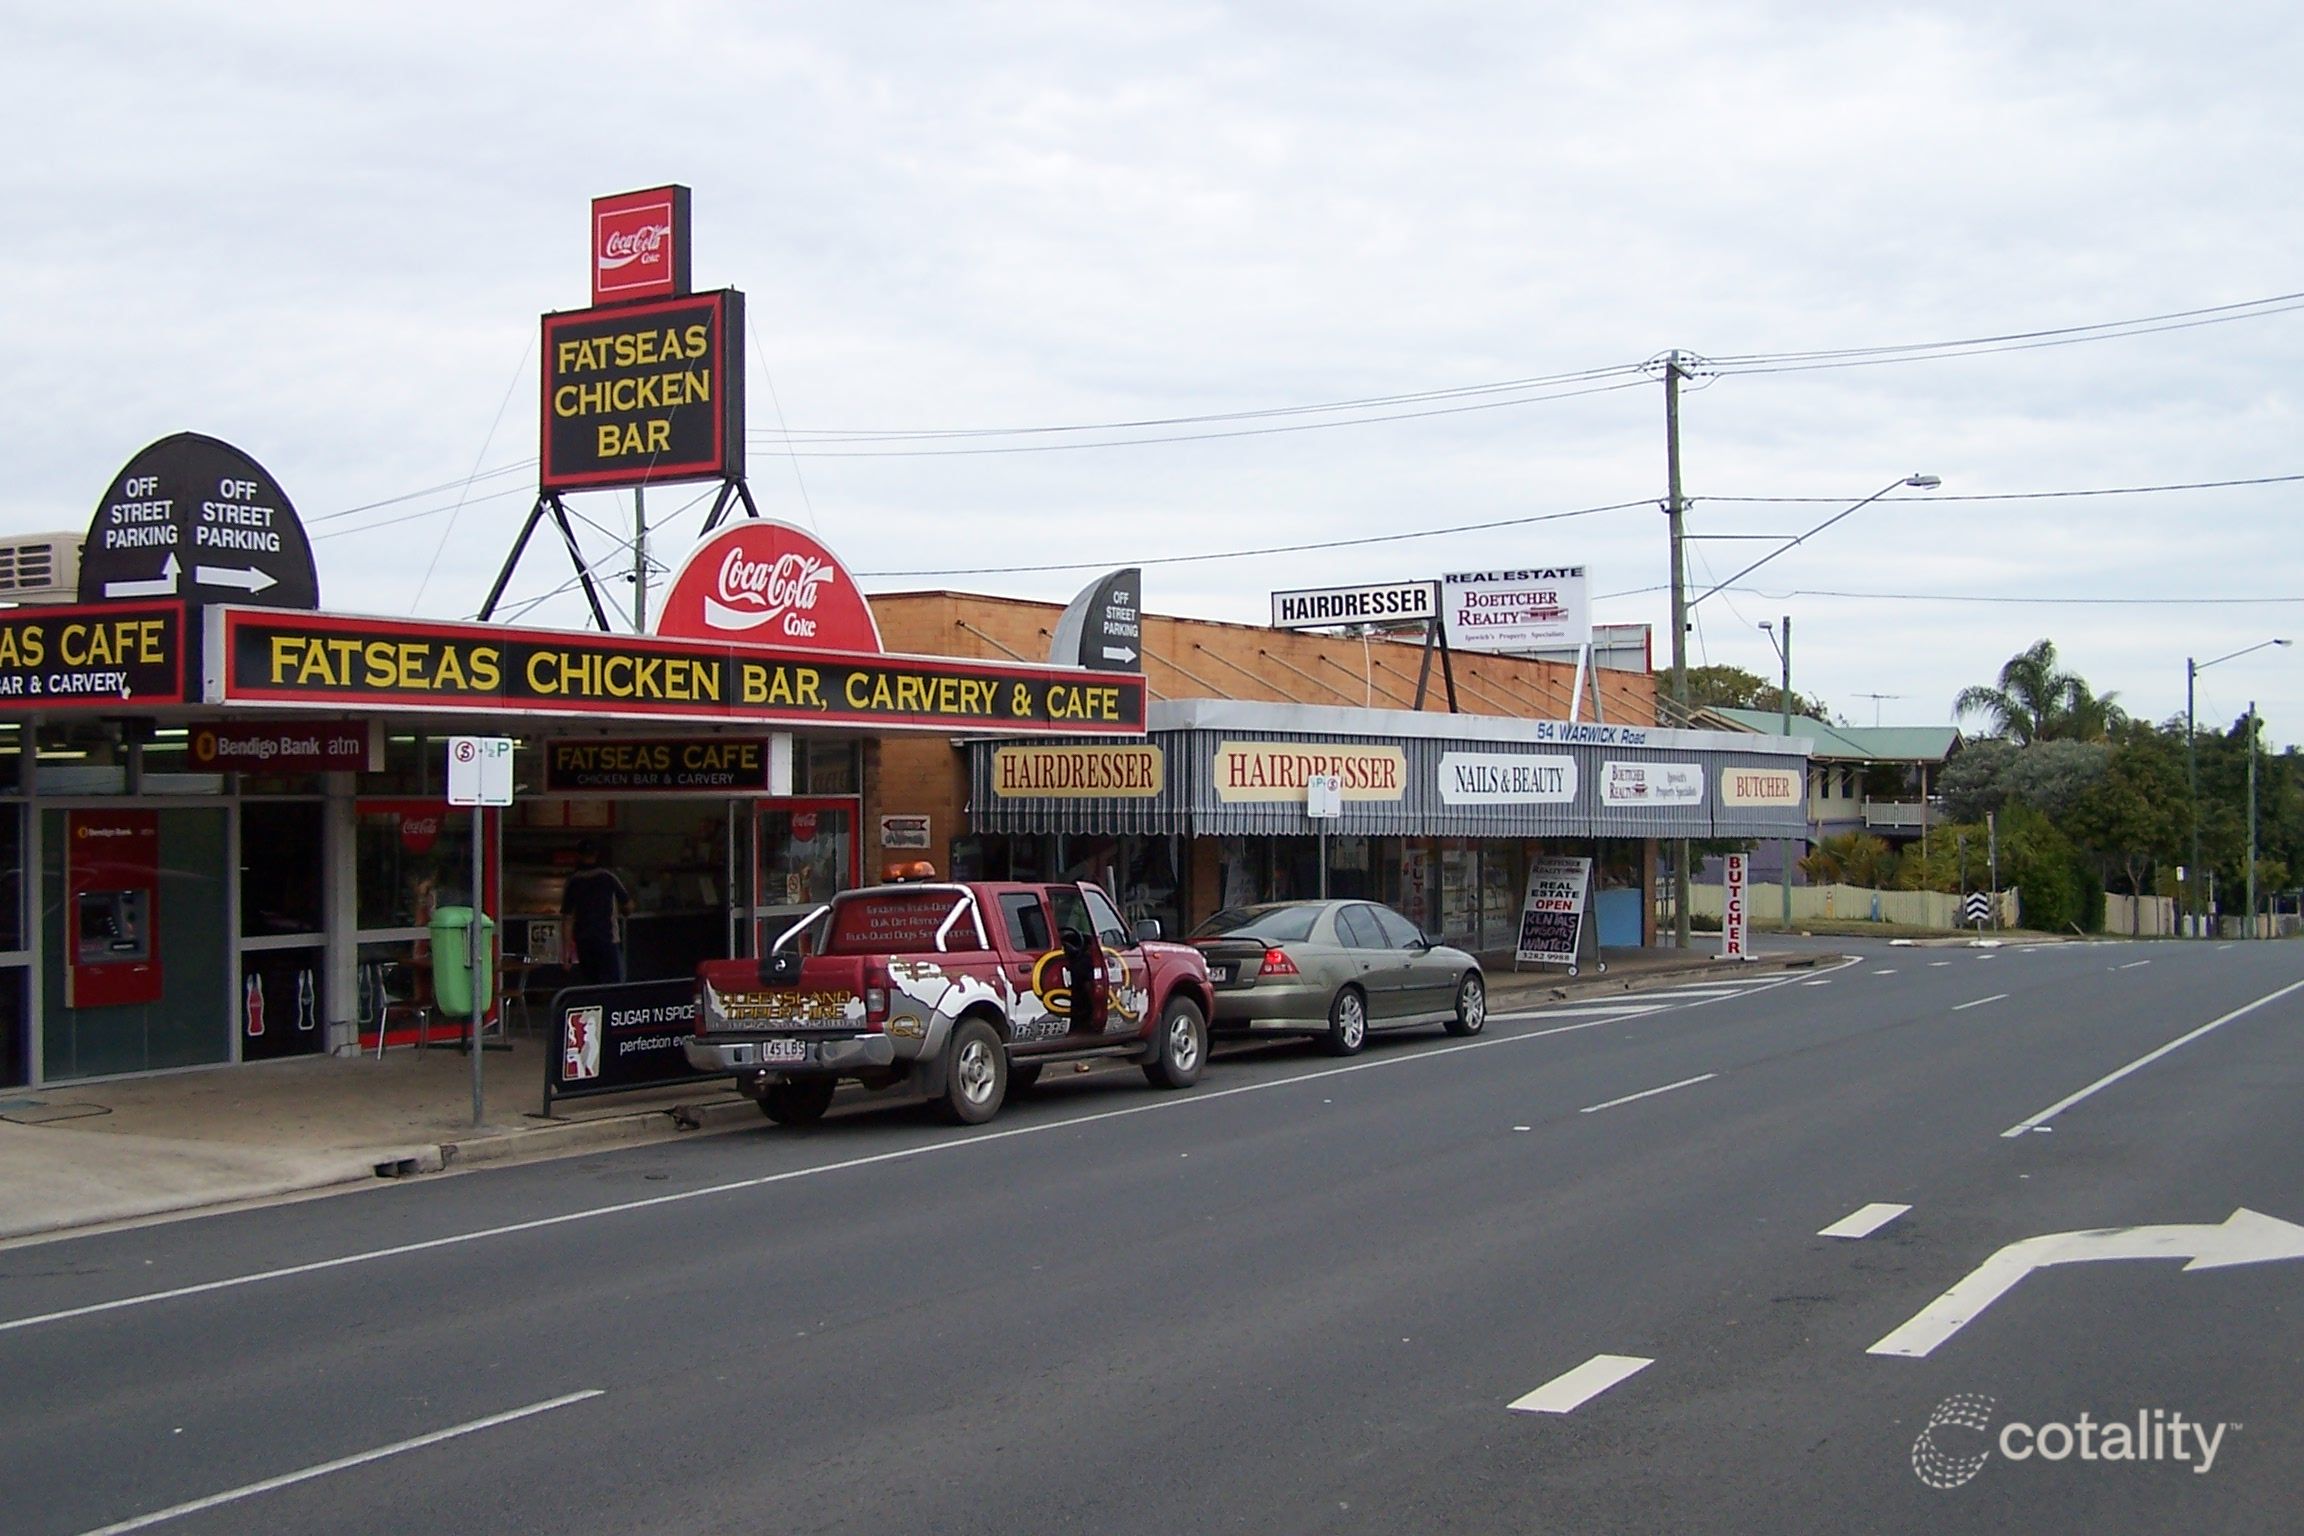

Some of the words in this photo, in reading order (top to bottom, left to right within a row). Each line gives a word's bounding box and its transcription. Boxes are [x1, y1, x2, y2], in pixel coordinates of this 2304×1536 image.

[606, 224, 661, 257] Coca-Cola
[558, 325, 707, 374] FATSEAS
[554, 369, 710, 417] CHICKEN
[597, 419, 671, 458] BAR
[126, 477, 158, 498] OFF
[220, 479, 258, 500] OFF
[111, 500, 174, 524] STREET
[203, 502, 274, 527] STREET
[105, 525, 178, 549] PARKING
[196, 526, 281, 552] PARKING
[718, 547, 823, 609] Coca-Cola
[1446, 573, 1499, 583] REAL
[1503, 568, 1584, 581] ESTATE
[1113, 591, 1129, 604] OFF
[1282, 589, 1427, 620] HAIRDRESSER
[1464, 591, 1558, 608] BOETTCHER
[784, 612, 816, 637] Coke
[1106, 606, 1136, 621] STREET
[1457, 609, 1520, 626] REALTY
[1103, 621, 1138, 637] PARKING
[61, 620, 164, 666] CAFE
[30, 675, 42, 693] &
[50, 672, 127, 693] CARVERY
[271, 636, 500, 690] FATSEAS
[526, 651, 719, 700] CHICKEN
[742, 664, 828, 712] BAR,
[845, 672, 999, 715] CARVERY
[1012, 683, 1032, 717] &
[1046, 685, 1119, 720] CAFE
[1538, 722, 1553, 740] 54
[1559, 723, 1616, 743] WARWICK
[1621, 729, 1646, 745] Road
[218, 737, 277, 759] Bendigo
[280, 737, 320, 755] Bank
[328, 739, 359, 755] atm
[557, 745, 670, 770] FATSEAS
[684, 744, 758, 769] CAFE
[577, 774, 627, 784] CHICKEN
[633, 774, 657, 784] BAR
[663, 773, 671, 784] &
[678, 773, 735, 784] CARVERY
[1002, 753, 1154, 789] HAIRDRESSER
[1456, 766, 1498, 792] NAILS
[1500, 768, 1511, 792] &
[1513, 767, 1564, 793] BEAUTY
[1736, 776, 1789, 798] BUTCHER
[1531, 889, 1579, 898] ESTATE
[1540, 881, 1573, 889] REAL
[1536, 900, 1572, 910] OPEN
[1728, 856, 1741, 953] BUTCHER
[720, 990, 852, 1005] QUEENSLAND
[611, 1009, 649, 1026] SUGAR
[652, 1008, 664, 1021] 'N
[665, 1004, 695, 1021] SPICE
[620, 1035, 670, 1056] perfection
